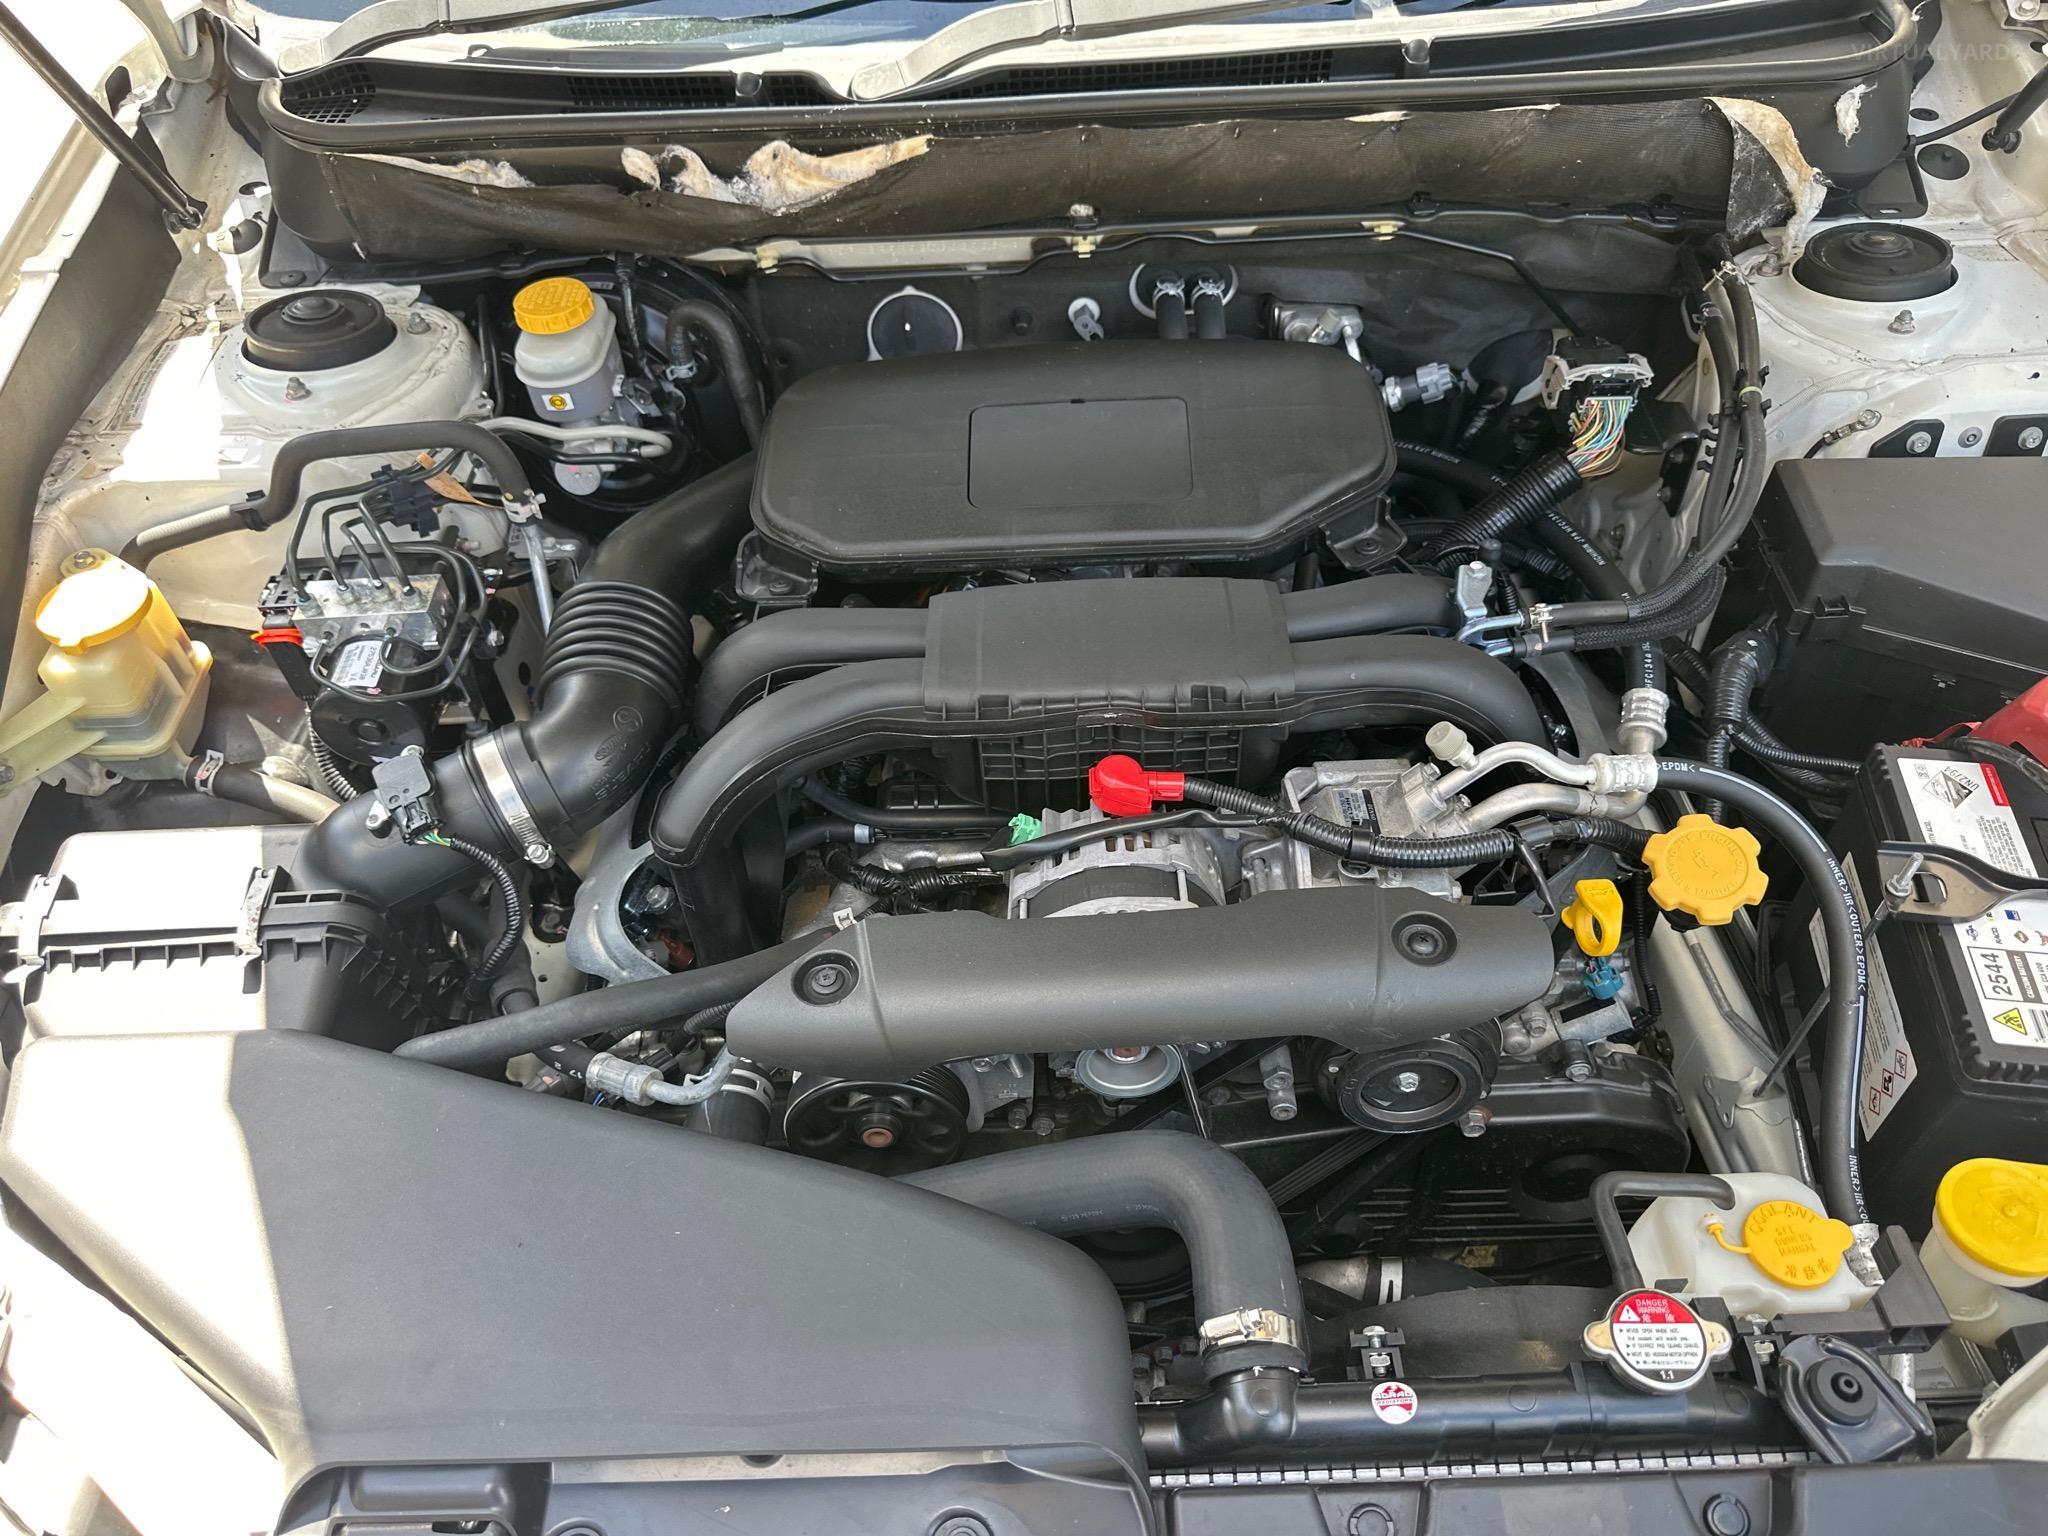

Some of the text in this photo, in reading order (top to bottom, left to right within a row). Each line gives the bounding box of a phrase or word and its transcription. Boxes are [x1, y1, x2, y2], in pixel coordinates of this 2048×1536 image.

[1944, 766, 1980, 791] UN2794
[1980, 953, 2013, 997] 2544
[1750, 1203, 1818, 1234] COOLANT
[1635, 1299, 1668, 1307] DANGER
[1637, 1306, 1670, 1314] WARNING
[1660, 1370, 1675, 1380] 1.1
